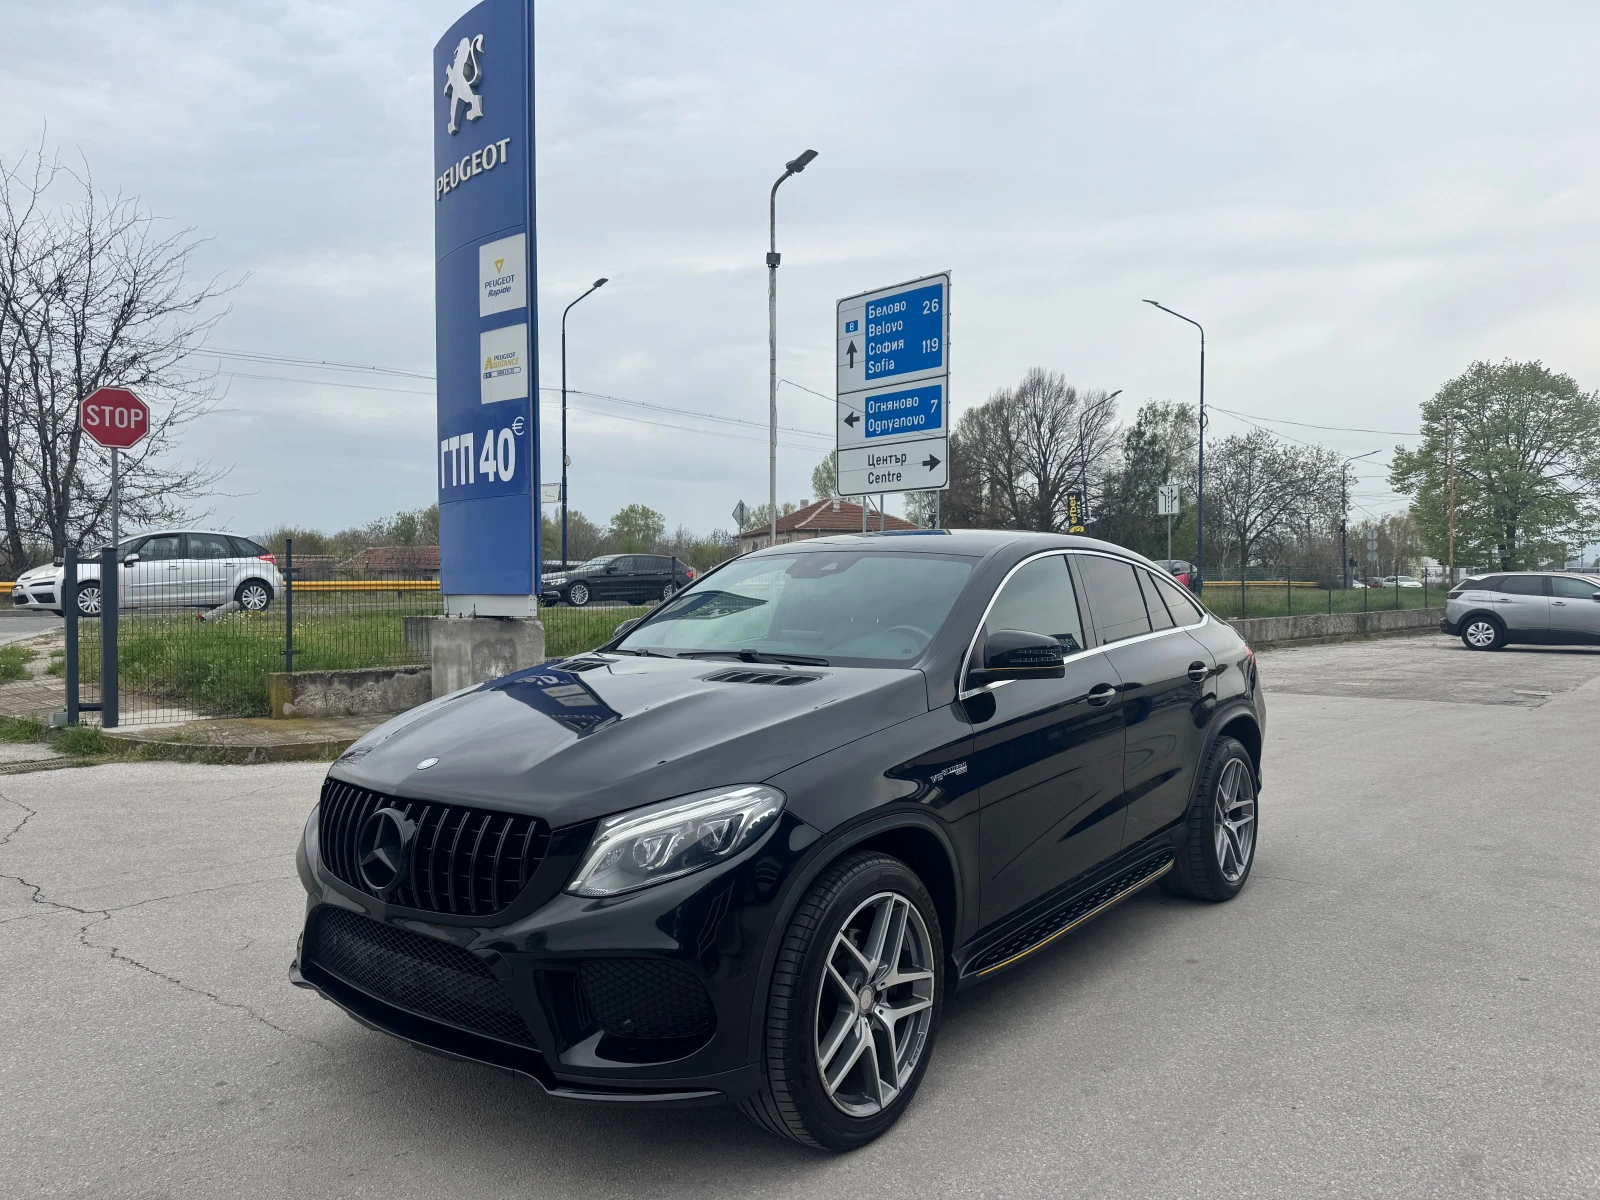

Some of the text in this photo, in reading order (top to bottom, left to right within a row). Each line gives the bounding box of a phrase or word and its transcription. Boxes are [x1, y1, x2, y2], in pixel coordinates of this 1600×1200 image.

[436, 137, 511, 201] PEUGEOT
[484, 274, 515, 289] PEUGEOT
[487, 286, 512, 297] Rapide
[868, 298, 939, 319] Белово 26
[849, 322, 855, 331] 8
[868, 320, 904, 337] Belovo
[868, 337, 939, 355] София 119
[493, 351, 516, 361] PEUGEOT
[868, 358, 895, 374] Sofia
[868, 396, 938, 414] Огняново 7
[86, 404, 144, 429] STOP
[868, 414, 925, 434] Ognyanovo
[440, 432, 475, 490] ГТП
[867, 452, 907, 468] Център
[867, 470, 902, 484] Centre
[1069, 495, 1078, 524] efbet
